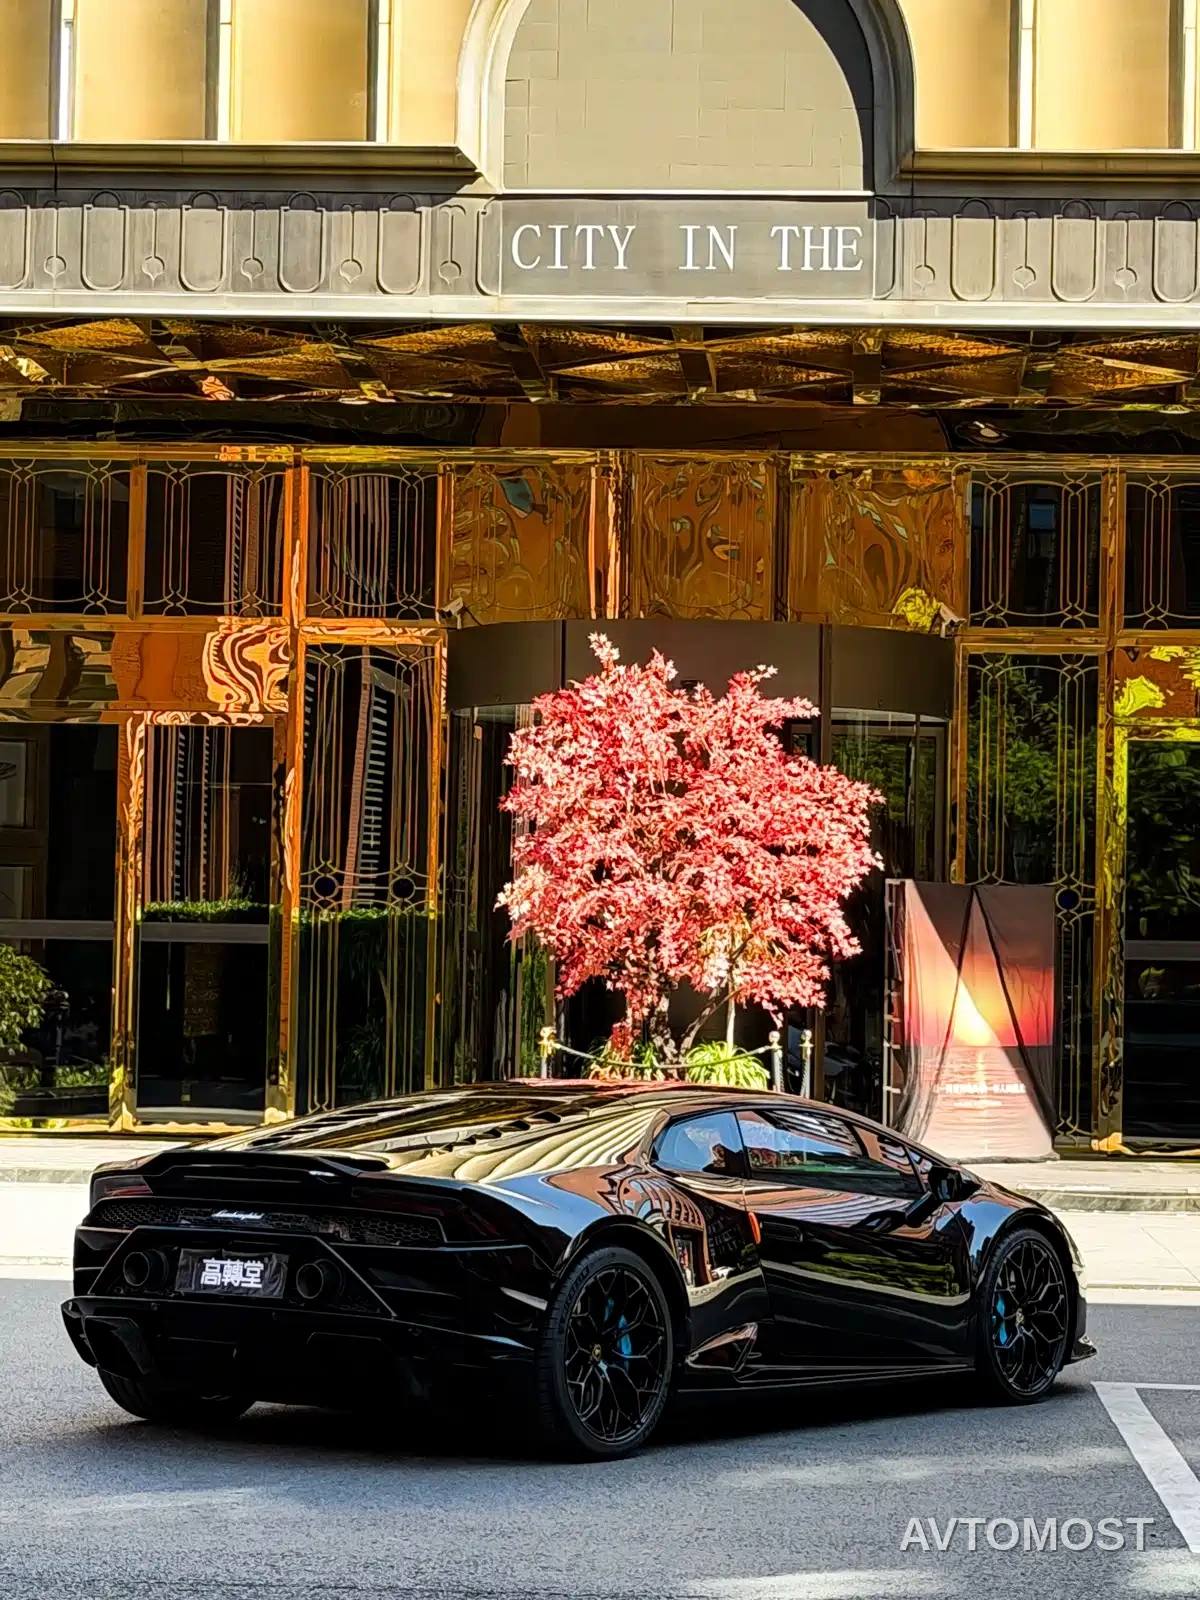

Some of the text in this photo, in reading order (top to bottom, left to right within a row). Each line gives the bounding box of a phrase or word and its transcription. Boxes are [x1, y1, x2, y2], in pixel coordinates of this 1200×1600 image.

[511, 224, 864, 271] CITY IN THE
[200, 1257, 264, 1288] 高轉堂
